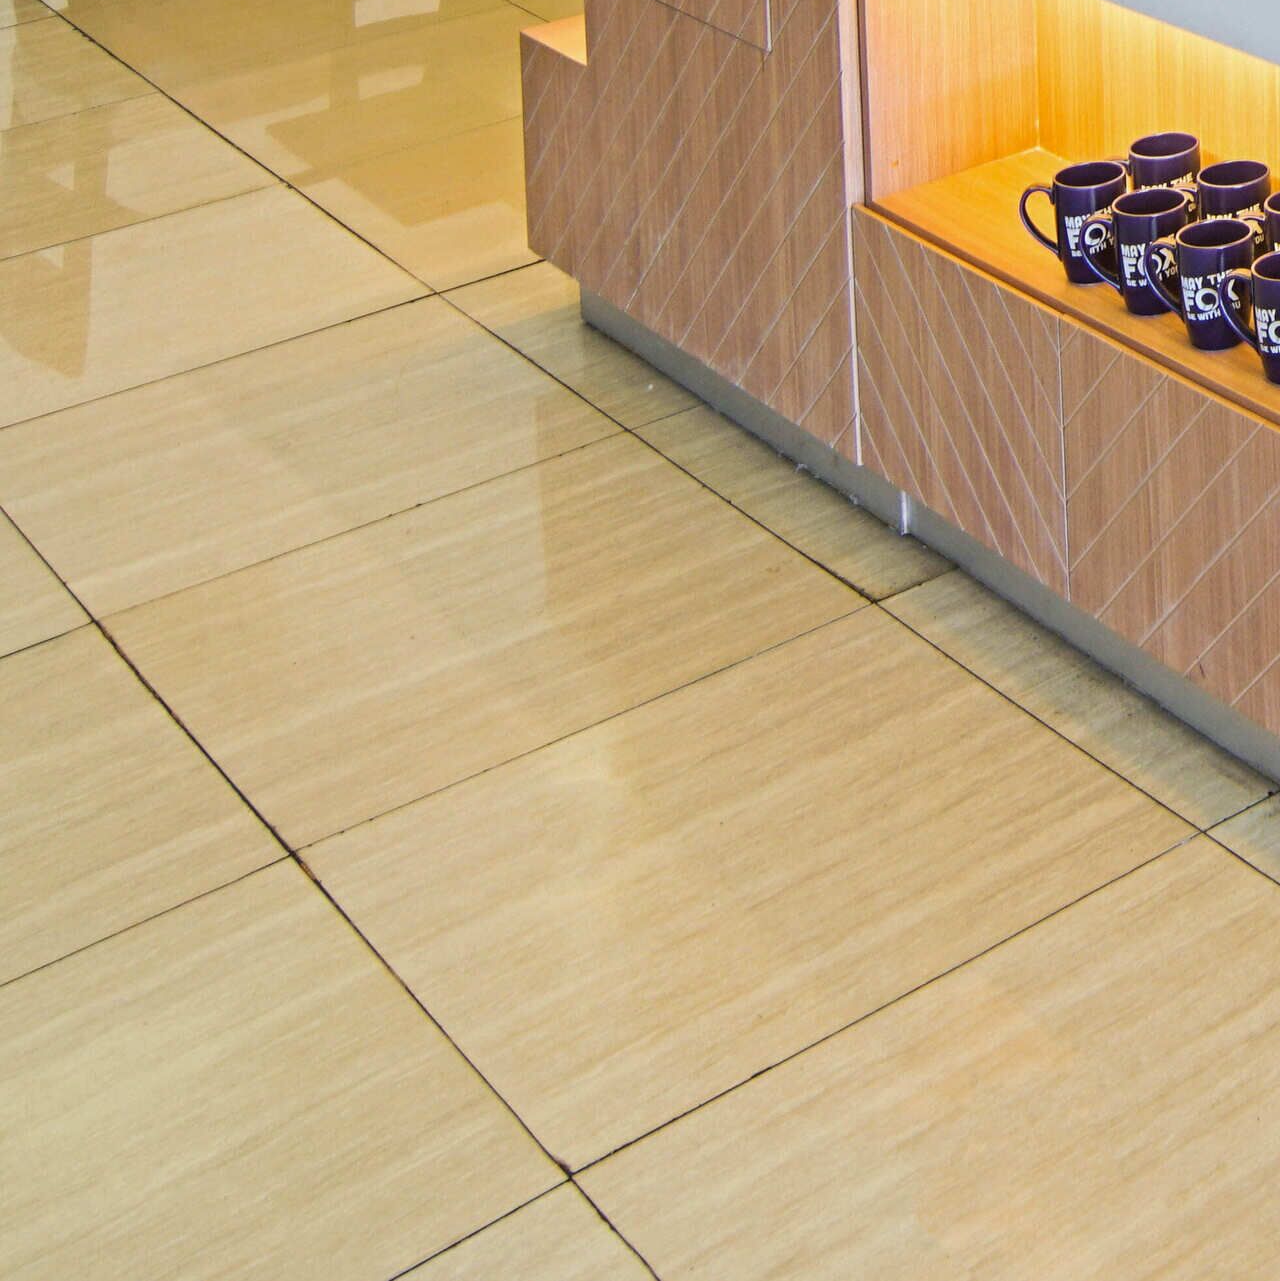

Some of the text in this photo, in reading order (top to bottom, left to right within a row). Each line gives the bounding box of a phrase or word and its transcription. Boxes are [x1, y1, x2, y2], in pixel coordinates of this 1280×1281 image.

[1121, 243, 1146, 258] MAY
[1181, 276, 1203, 290] MAY
[1255, 306, 1276, 322] MAY
